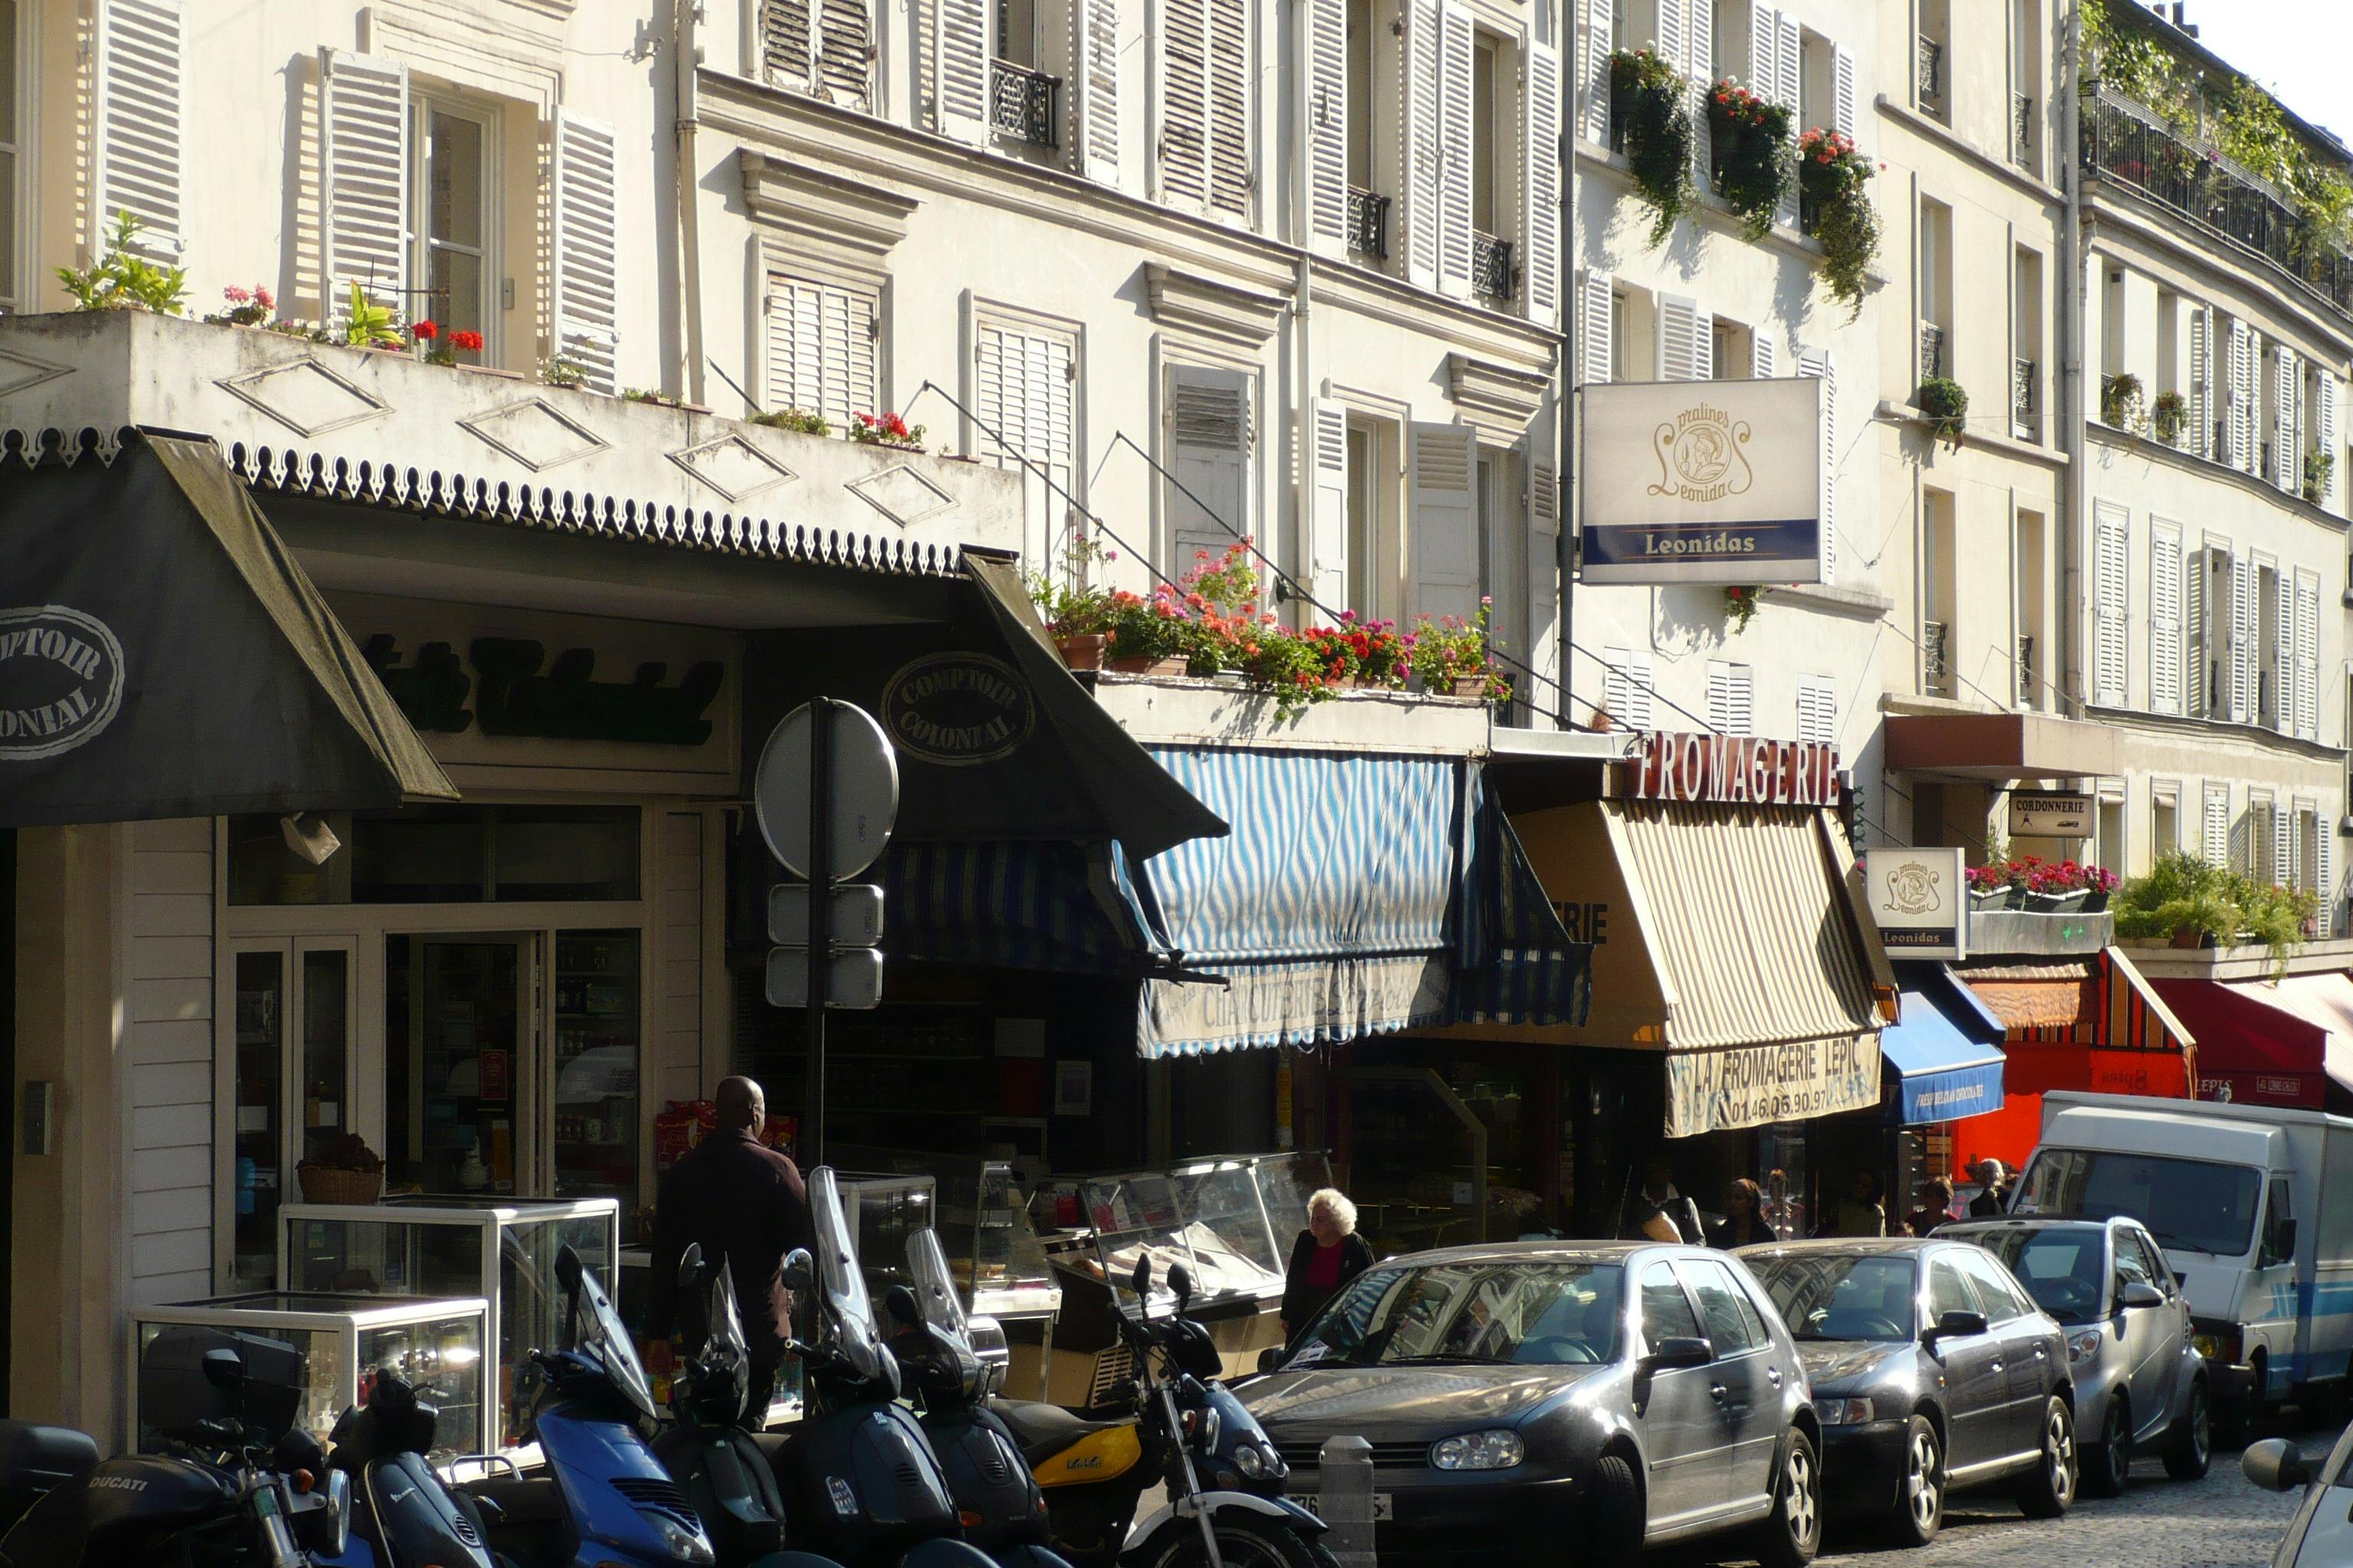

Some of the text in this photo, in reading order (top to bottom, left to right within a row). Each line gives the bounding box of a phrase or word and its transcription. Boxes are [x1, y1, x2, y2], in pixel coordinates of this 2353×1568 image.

[1677, 403, 1730, 432] pralines
[1645, 532, 1755, 555] Leonidas
[901, 668, 1017, 710] COMPTOIR
[900, 711, 1016, 750] COLONIAL
[1637, 732, 1840, 807] FROMAGERIE
[2016, 800, 2084, 813] CORDONNERIE
[1551, 902, 1607, 944] RIE
[1884, 931, 1940, 944] Leonidas
[1202, 977, 1327, 1029] CHARCUTERIE
[1694, 1039, 1861, 1093] LA FROMAGERIE LEPIC
[1732, 1089, 1826, 1123] 01.46.06.90.97
[89, 1476, 149, 1491] DUCATI
